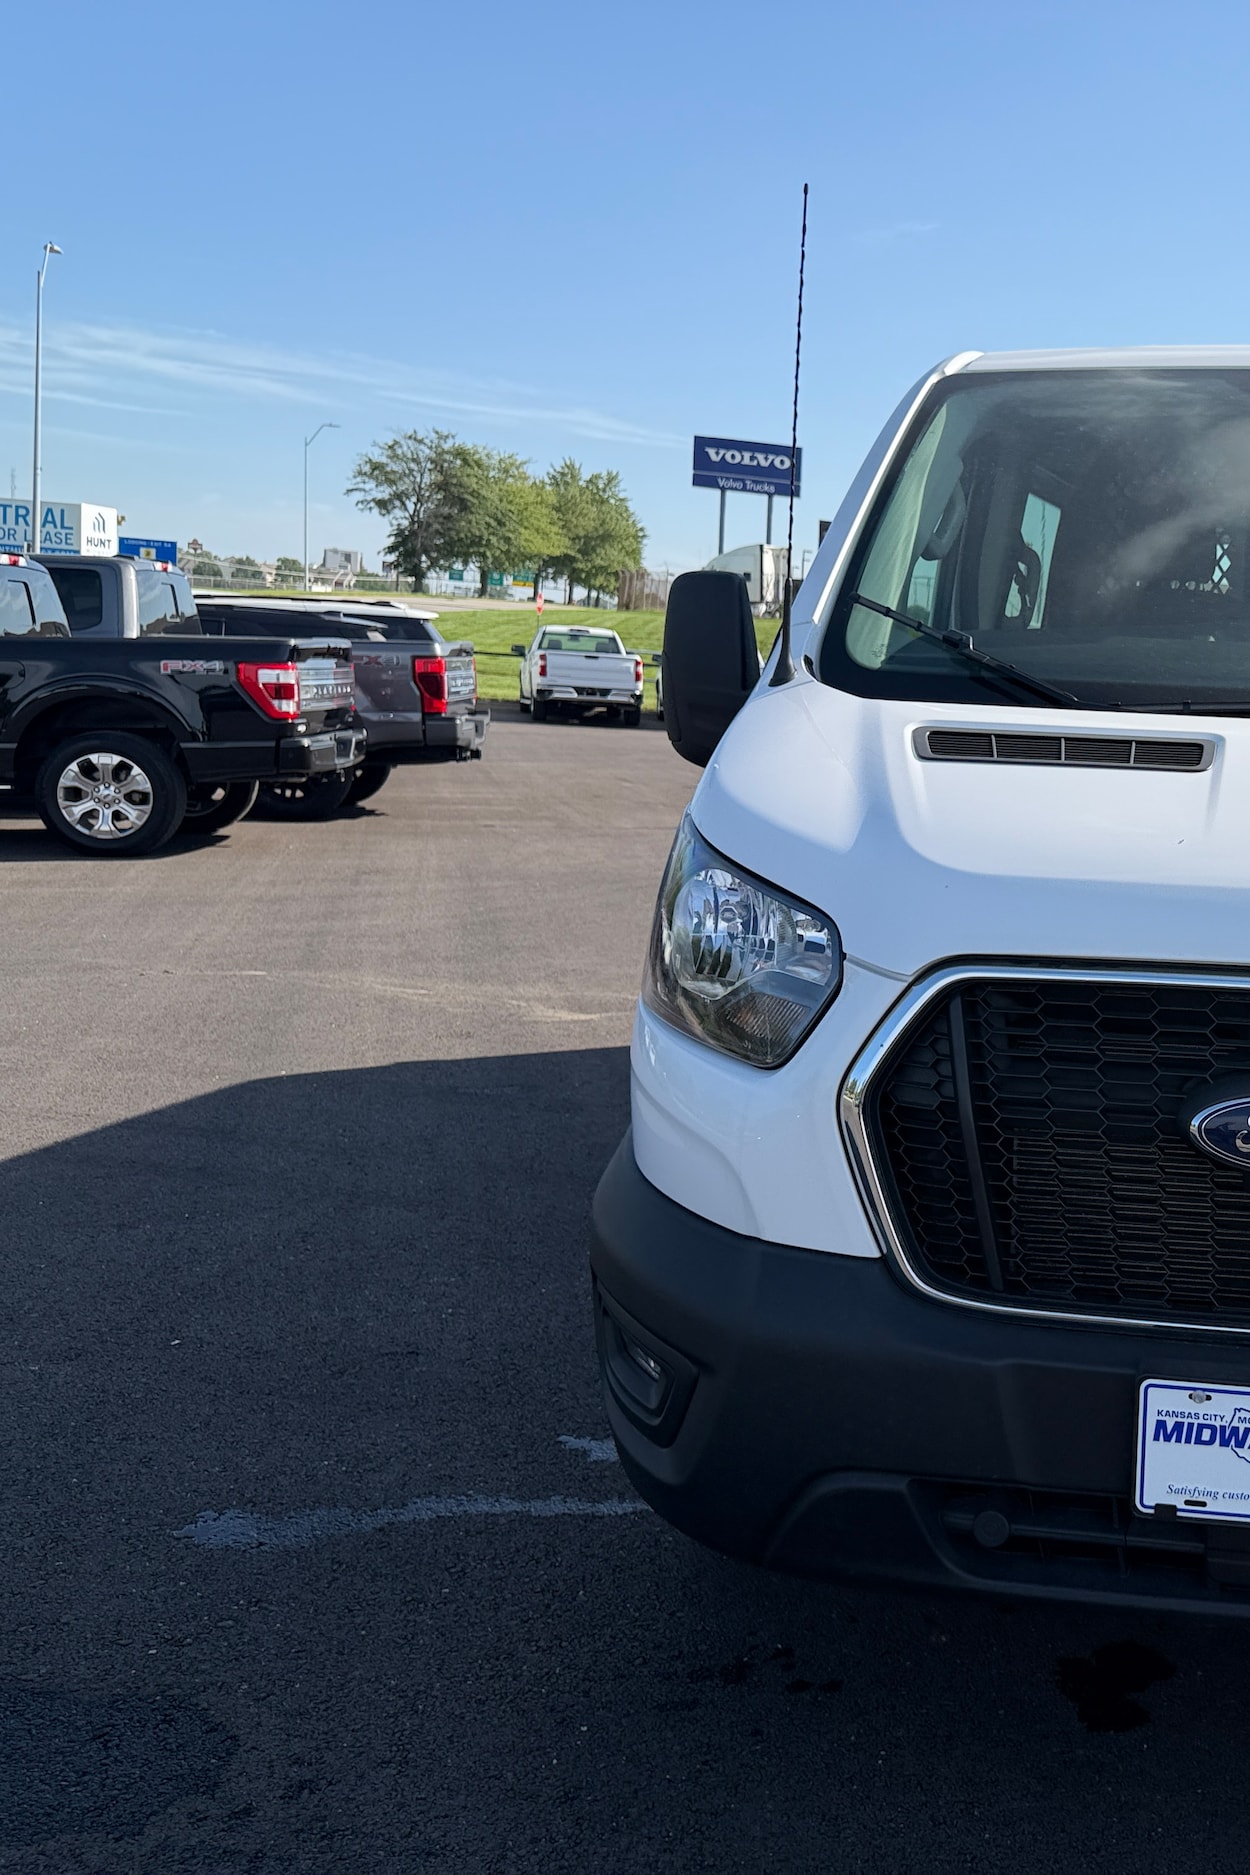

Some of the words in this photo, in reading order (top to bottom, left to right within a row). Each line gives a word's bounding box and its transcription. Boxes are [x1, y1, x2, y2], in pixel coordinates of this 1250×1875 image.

[704, 446, 792, 470] VOLVO
[717, 477, 743, 490] Volvo
[745, 480, 776, 494] Trucks
[86, 535, 112, 549] HUNT
[160, 659, 225, 675] FX4
[1157, 1409, 1200, 1421] KANSAS
[1202, 1412, 1228, 1424] CITY,
[1166, 1483, 1220, 1500] Satisfying
